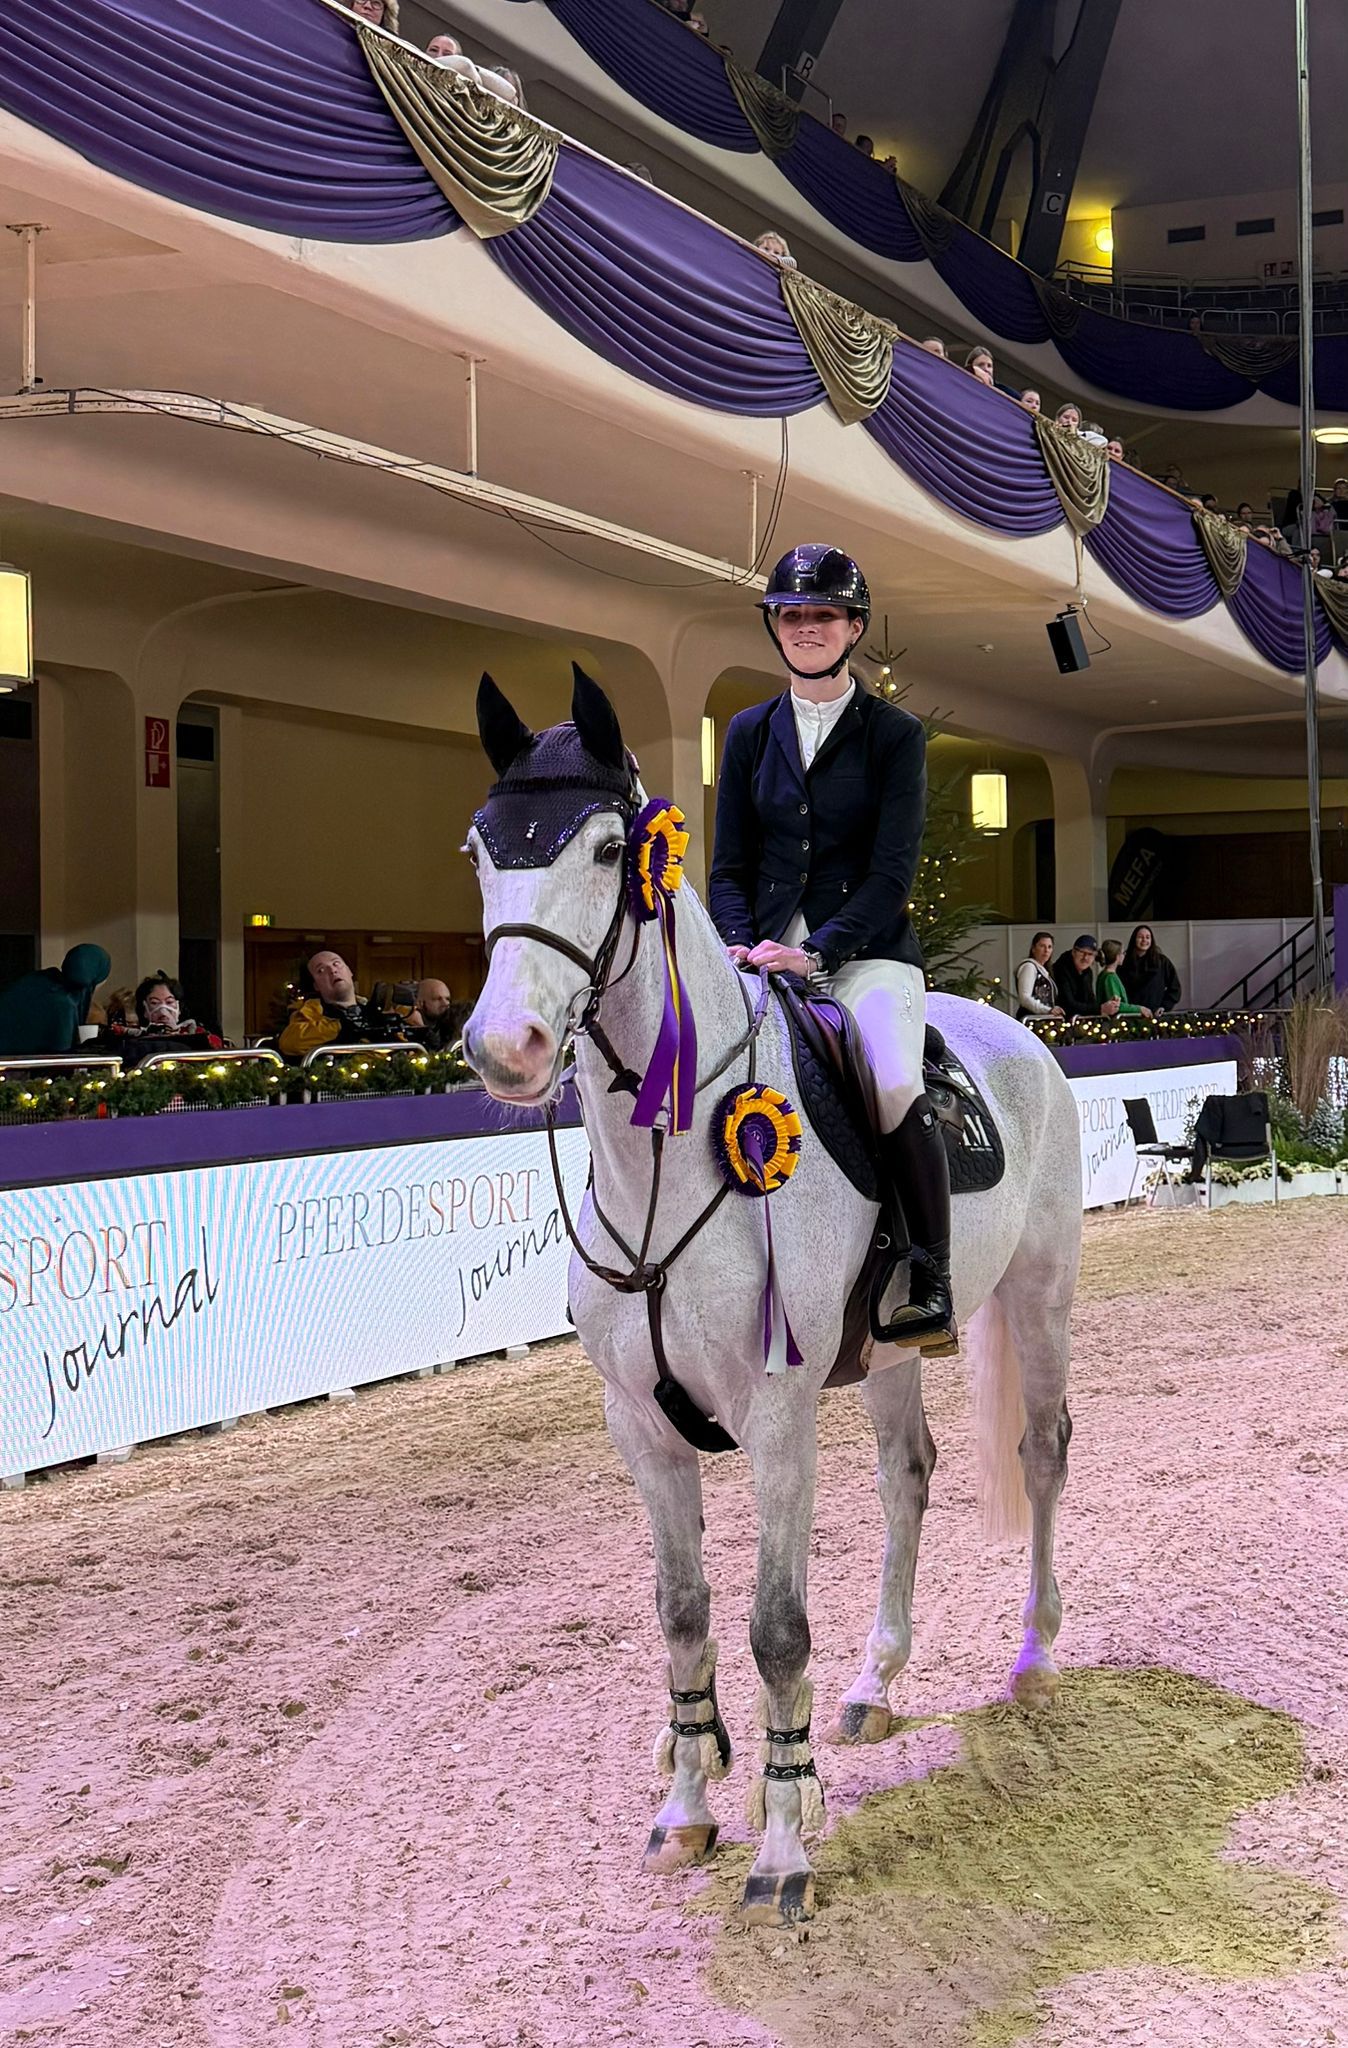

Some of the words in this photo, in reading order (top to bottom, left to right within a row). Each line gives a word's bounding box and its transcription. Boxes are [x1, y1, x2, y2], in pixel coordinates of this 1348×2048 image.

[1047, 194, 1062, 213] C
[1114, 848, 1156, 907] MEFA
[1076, 1097, 1118, 1134] PORT
[1086, 1121, 1129, 1195] journa
[273, 1169, 540, 1264] PFERDESPORT
